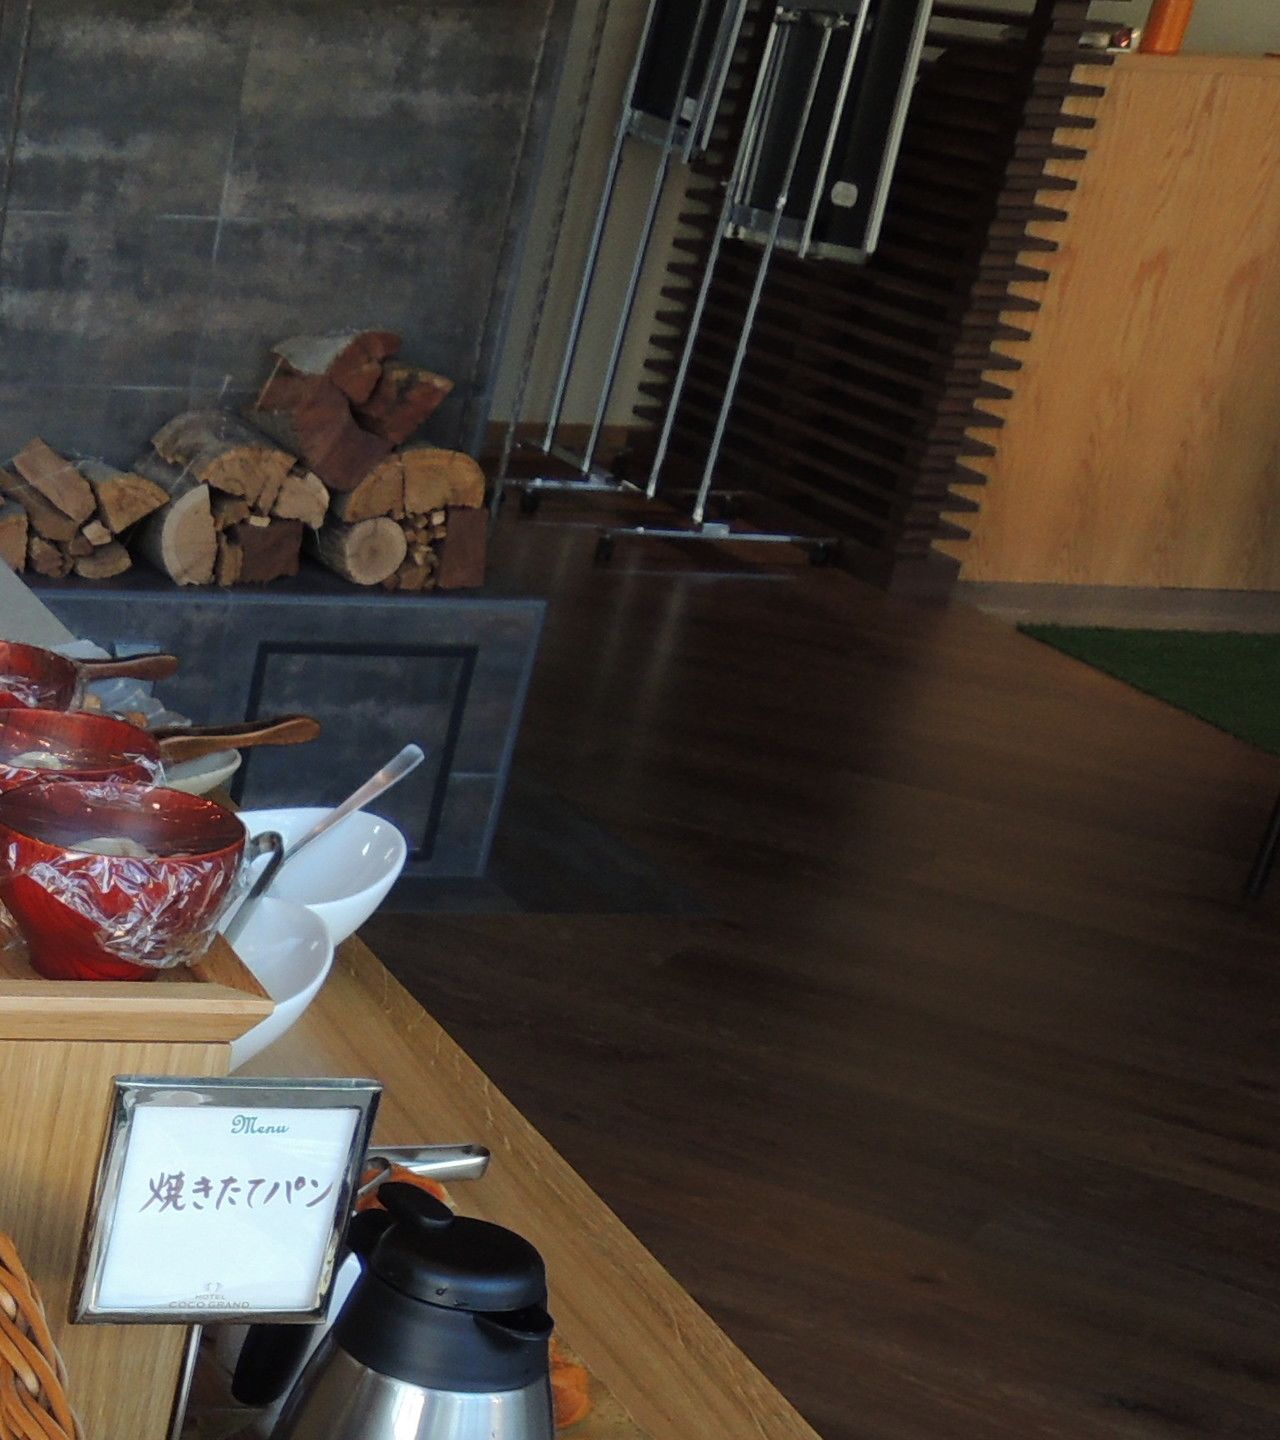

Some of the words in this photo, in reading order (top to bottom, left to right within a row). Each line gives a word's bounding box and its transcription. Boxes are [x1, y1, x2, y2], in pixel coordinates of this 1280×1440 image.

[231, 1115, 288, 1134] Menu
[140, 1171, 333, 1213] 焼きたてパン
[168, 1301, 206, 1309] COCO
[208, 1301, 250, 1309] GRAND
